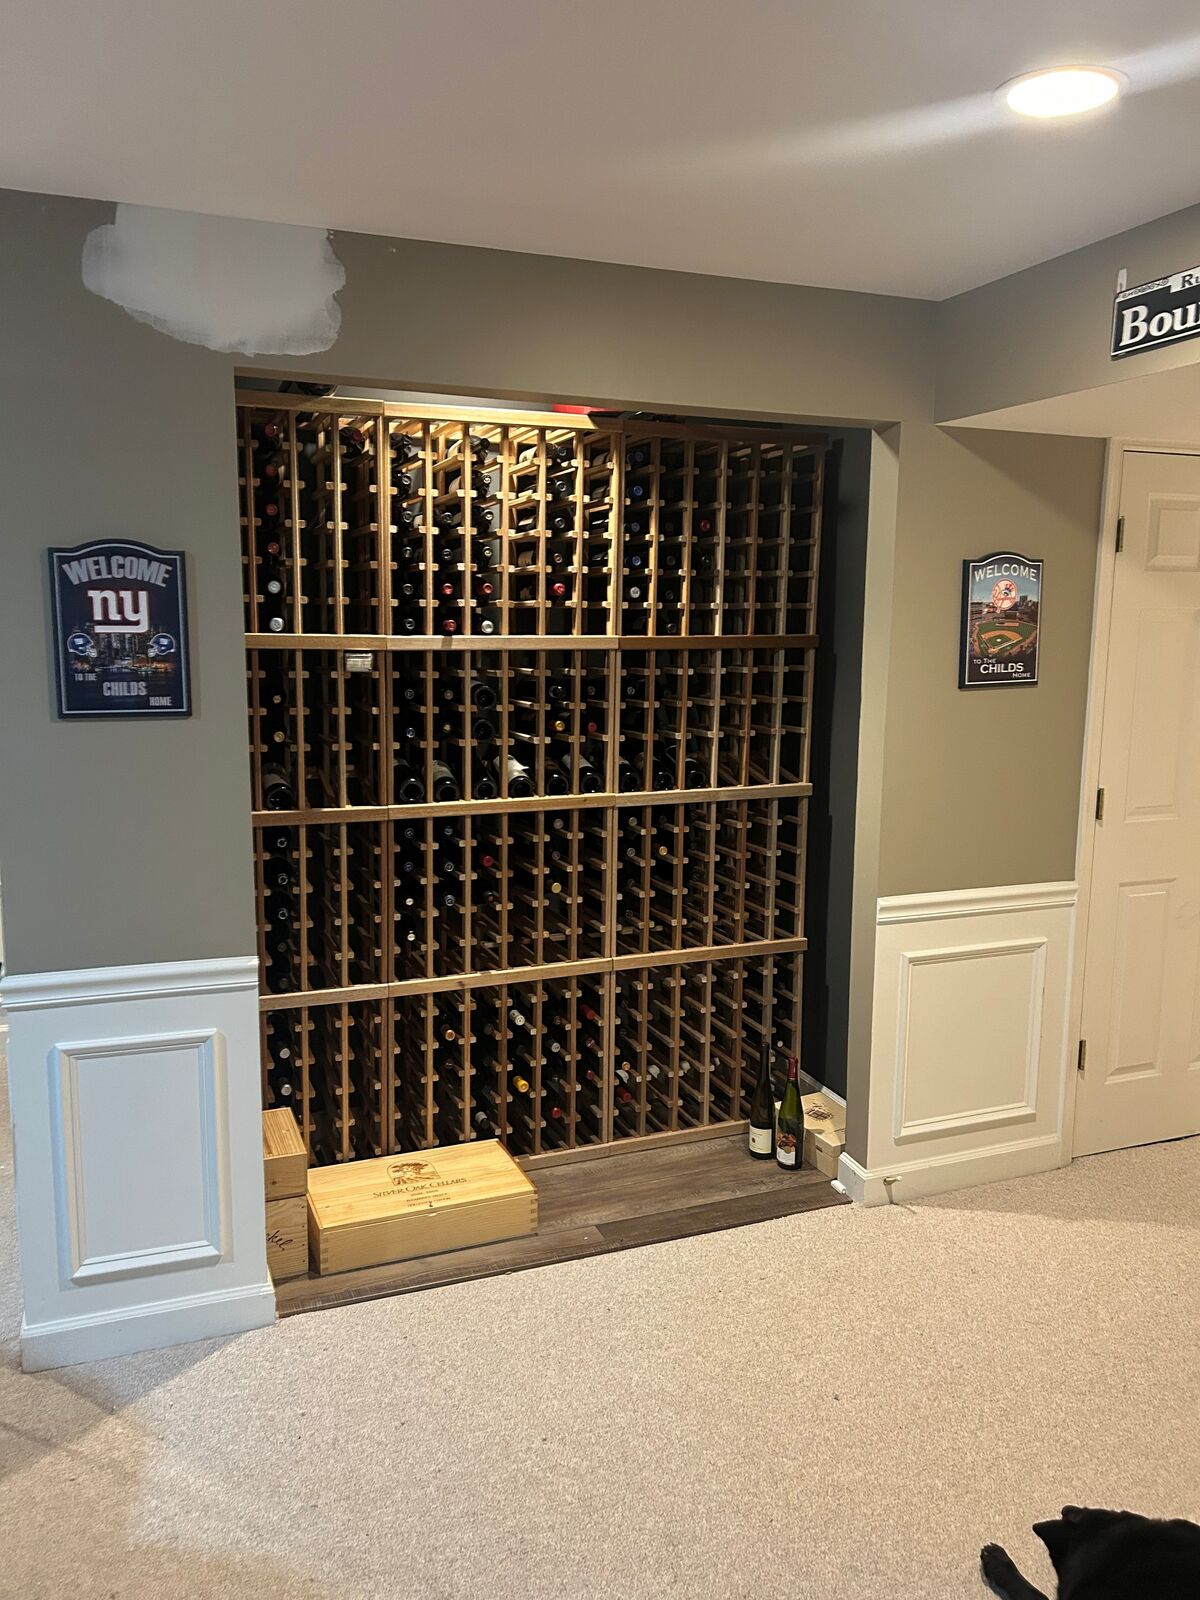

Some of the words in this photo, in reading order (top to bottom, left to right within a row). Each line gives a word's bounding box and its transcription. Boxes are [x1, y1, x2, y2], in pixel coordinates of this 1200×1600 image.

[1119, 302, 1200, 346] Bou
[62, 555, 173, 587] WELCOME
[974, 563, 1037, 582] WELCOME
[980, 662, 1024, 674] CHILDS
[74, 673, 83, 681] TO
[84, 673, 97, 681] THE
[103, 681, 147, 696] CHILDS
[149, 697, 172, 706] HOME
